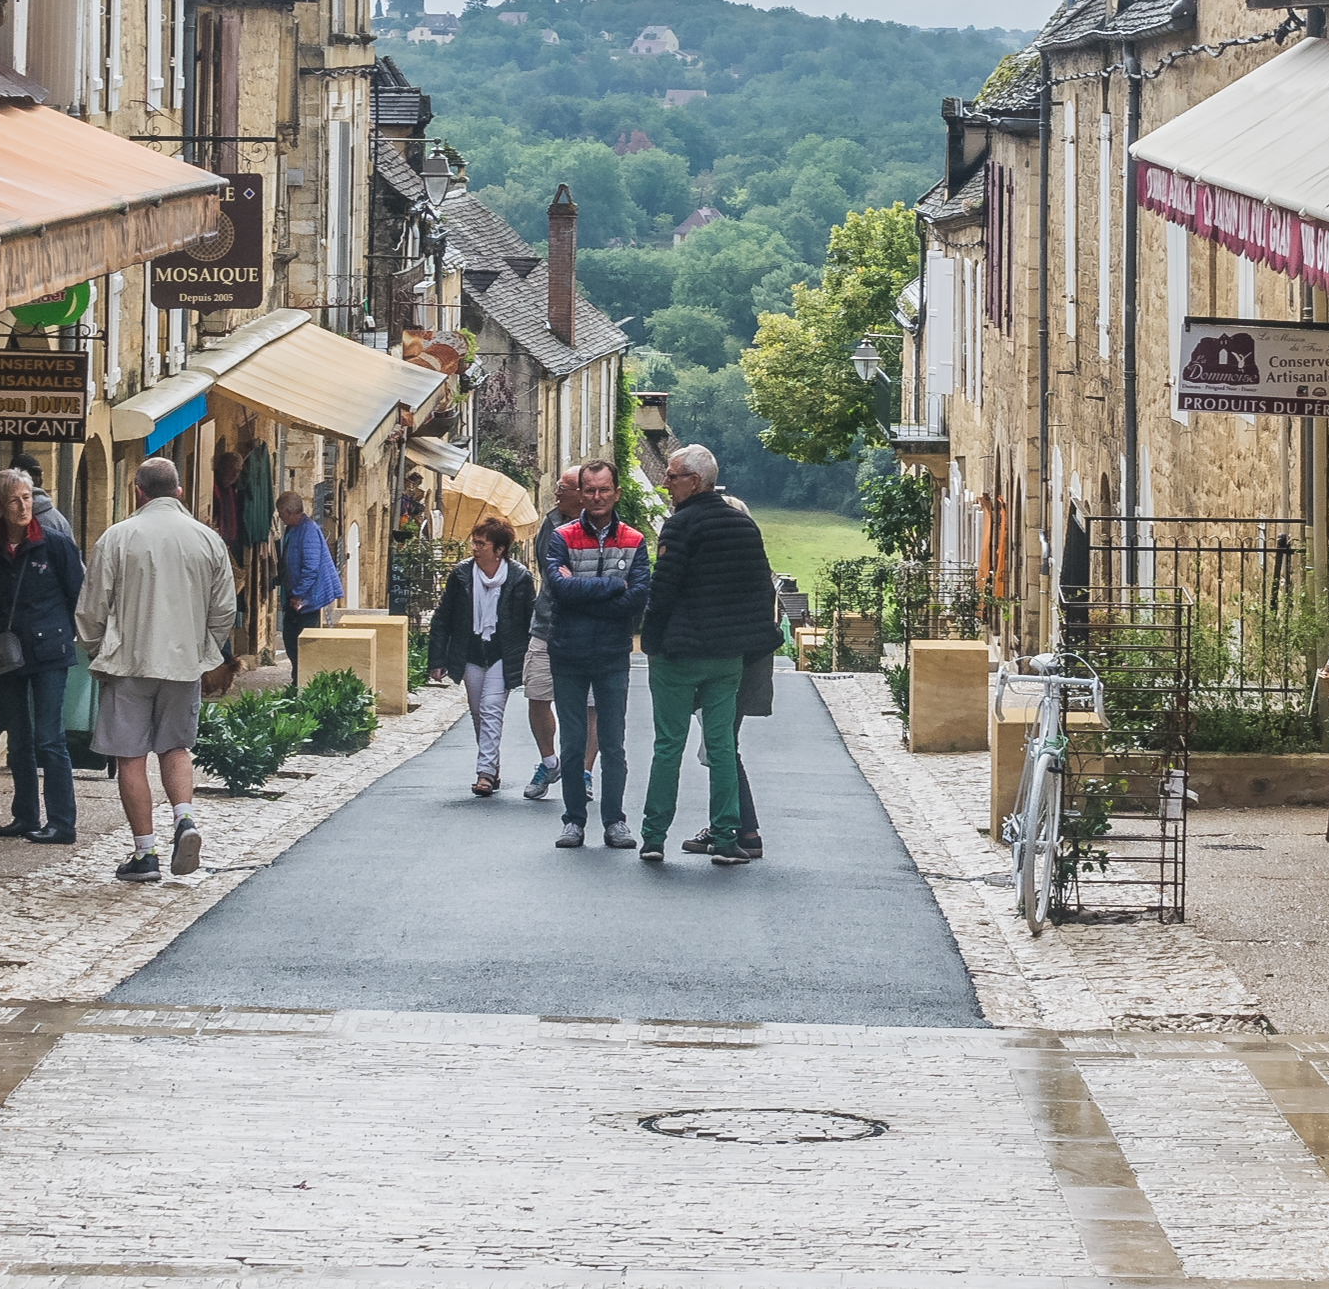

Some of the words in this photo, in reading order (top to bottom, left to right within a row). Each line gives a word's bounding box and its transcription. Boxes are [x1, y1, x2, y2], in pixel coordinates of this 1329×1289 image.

[155, 267, 259, 285] MOSAIQUE
[179, 293, 212, 304] Depuis
[213, 293, 234, 302] 2005
[1188, 363, 1258, 383] Dommoise
[29, 395, 80, 415] JOUVE
[1183, 396, 1267, 413] PRODUITS
[1273, 401, 1298, 414] DU
